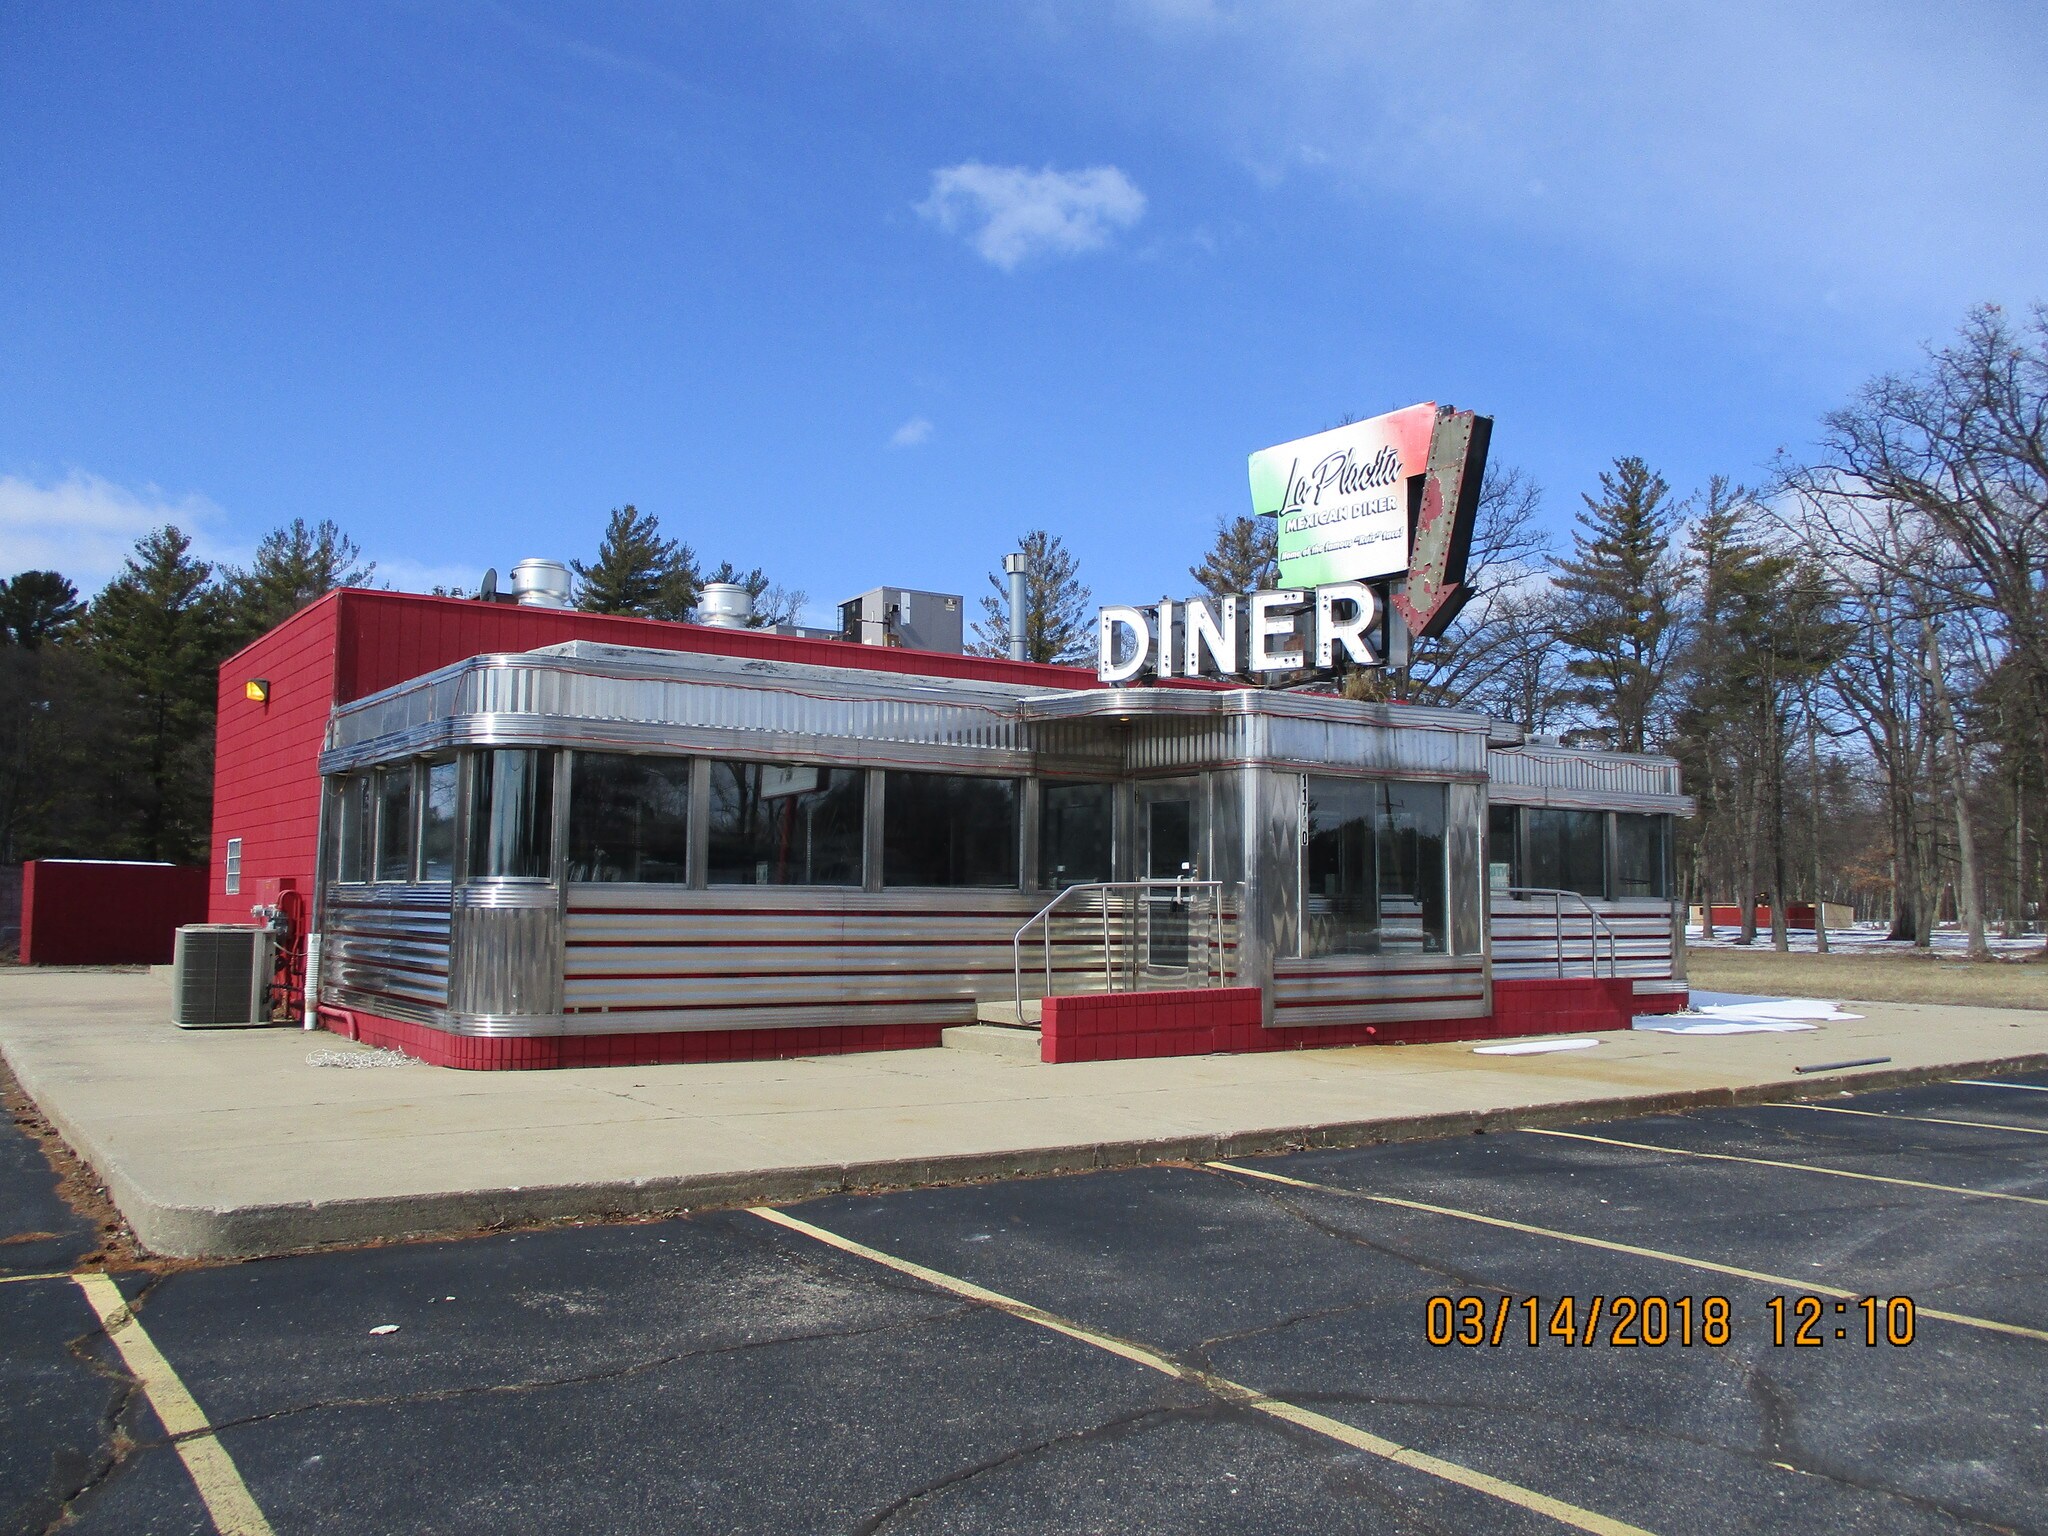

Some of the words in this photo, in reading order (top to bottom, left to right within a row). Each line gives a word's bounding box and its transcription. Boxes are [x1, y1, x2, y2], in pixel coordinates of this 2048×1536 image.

[1279, 457, 1313, 517] La
[1312, 445, 1403, 506] Placita
[1285, 506, 1349, 534] MEXICAN
[1351, 496, 1398, 518] DINER
[1280, 550, 1301, 562] Home
[1301, 546, 1312, 558] of
[1310, 543, 1324, 556] the
[1324, 539, 1354, 553] famous
[1098, 581, 1380, 683] DINER
